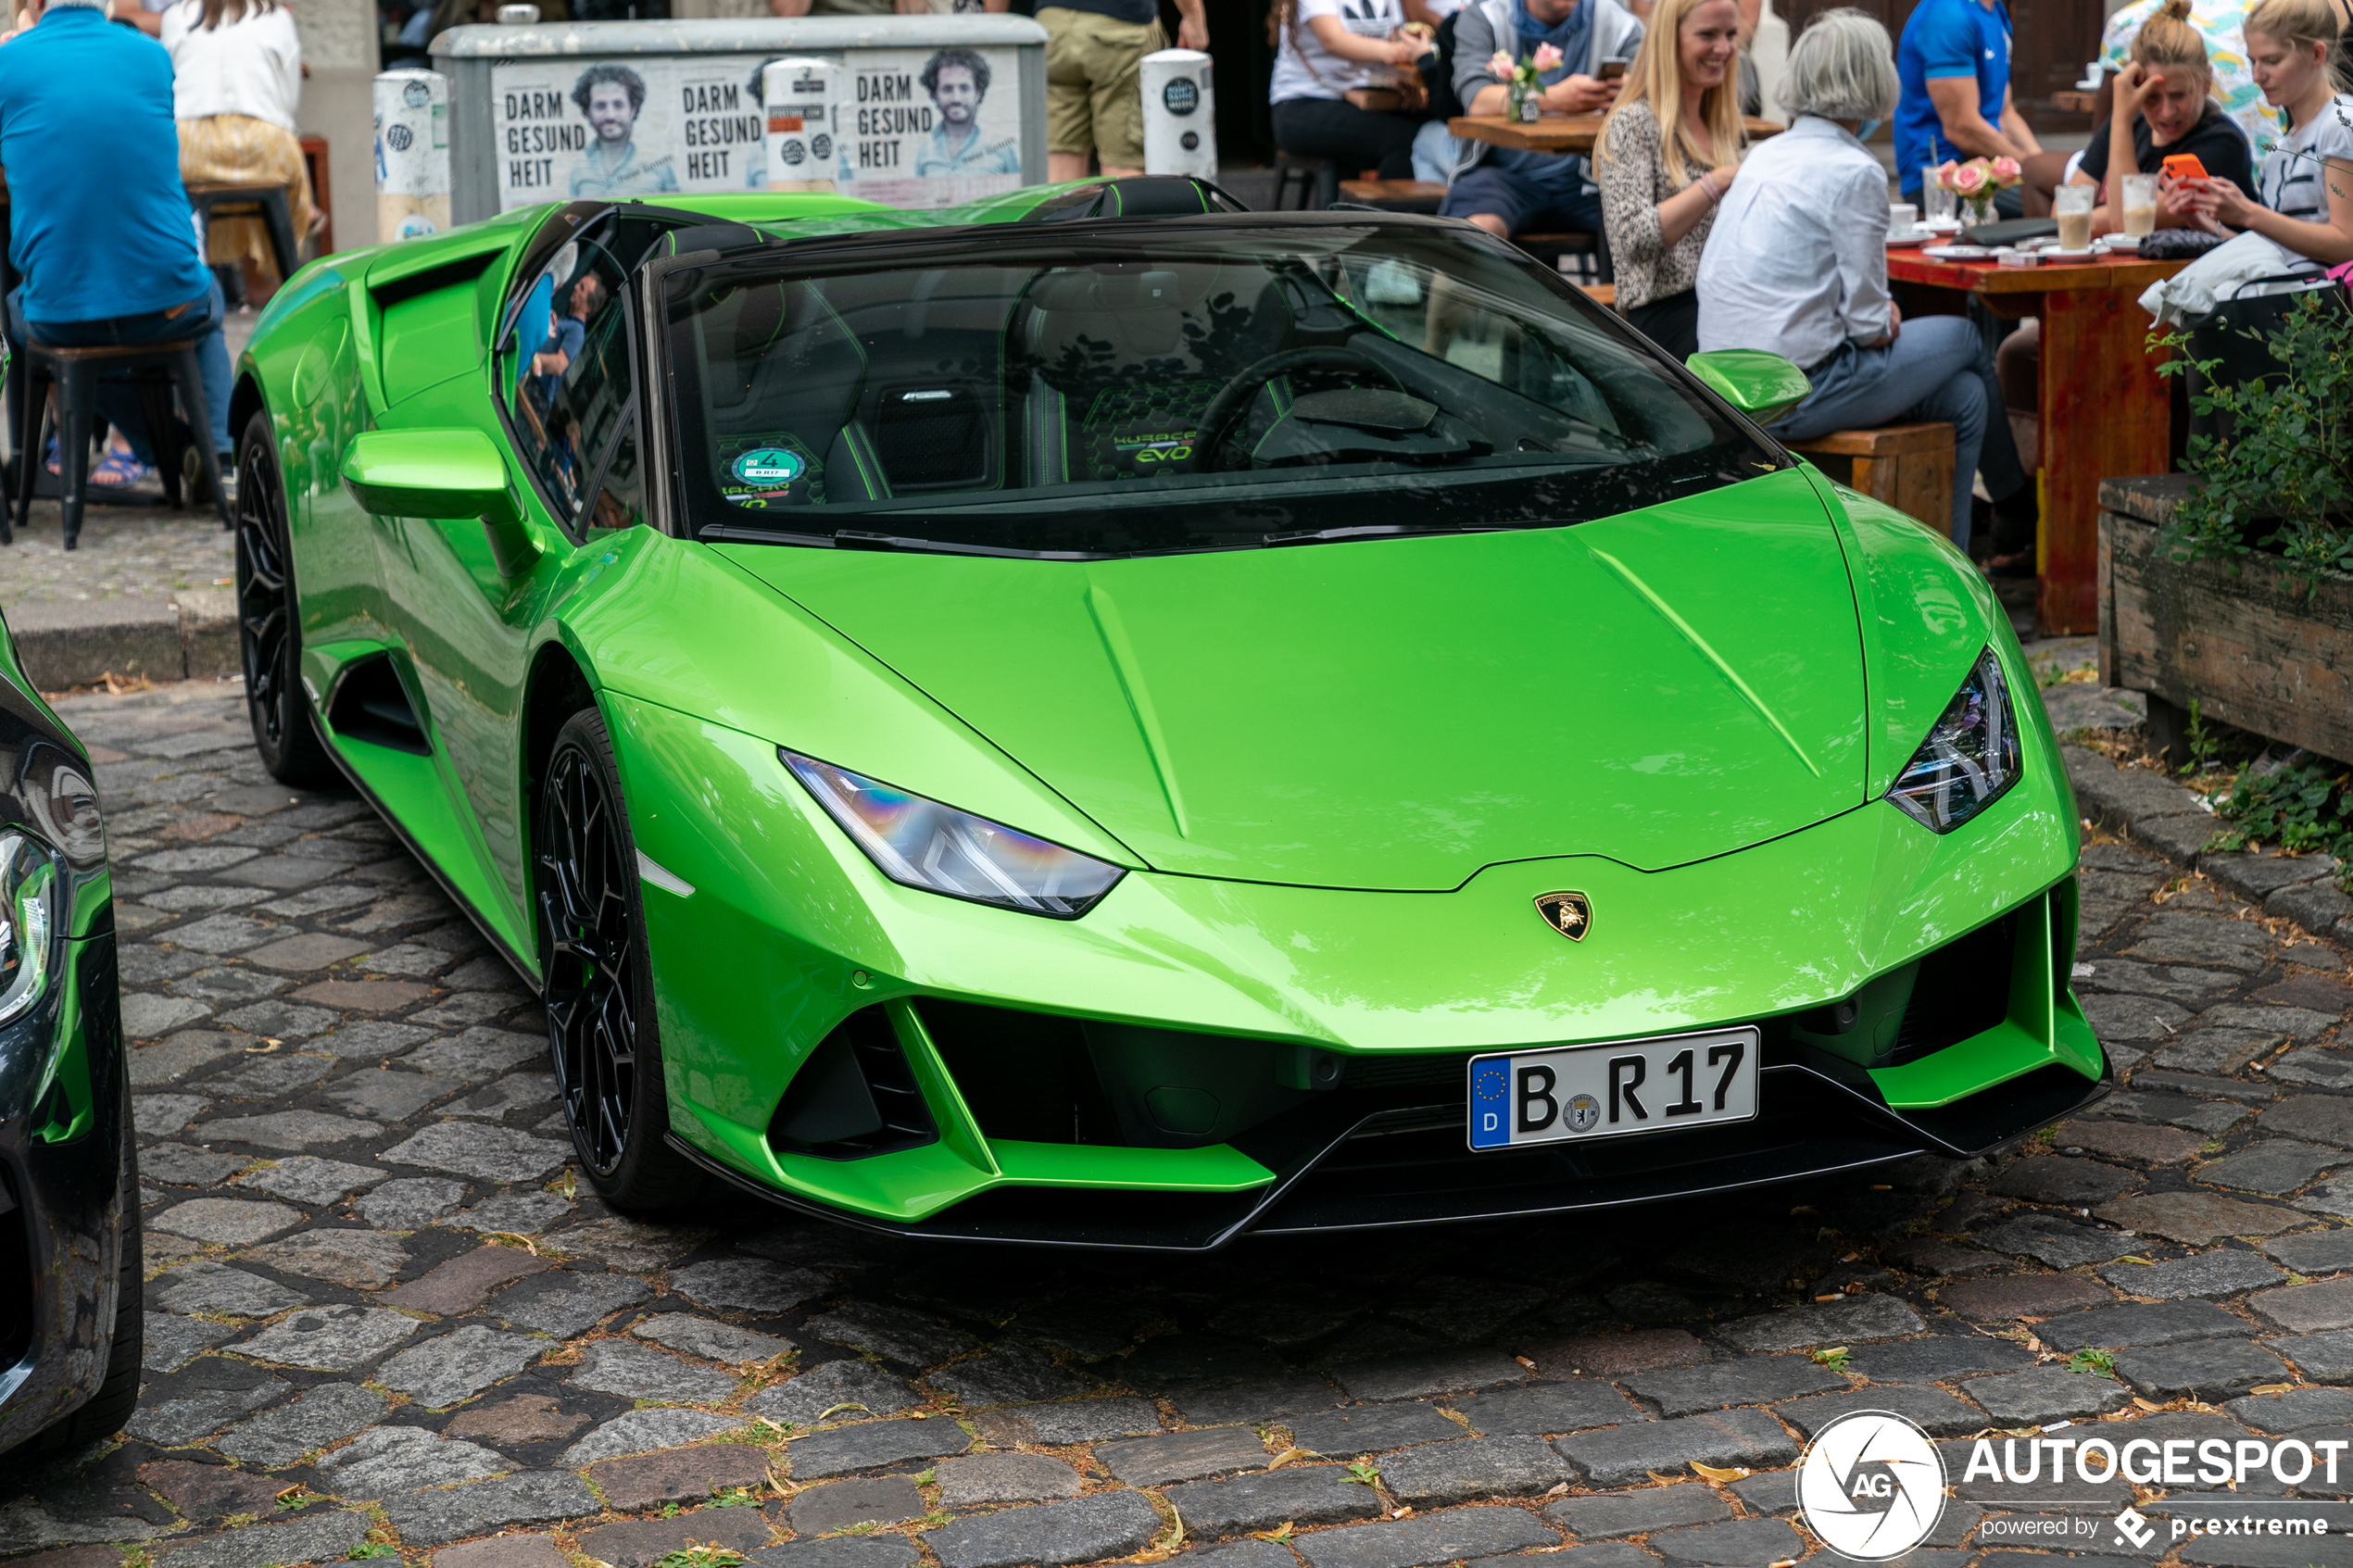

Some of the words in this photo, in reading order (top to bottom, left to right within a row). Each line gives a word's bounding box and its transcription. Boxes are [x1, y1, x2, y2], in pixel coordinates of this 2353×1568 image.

[683, 83, 739, 113] DARM
[857, 75, 912, 103] DARM
[505, 92, 564, 121] DARM
[686, 116, 761, 147] GESUND
[858, 107, 934, 136] GESUND
[508, 124, 586, 154] GESUND
[687, 151, 730, 181] HEIT
[860, 141, 901, 169] HEIT
[510, 159, 553, 188] HEIT
[761, 452, 778, 468] 4
[1135, 445, 1192, 463] EVO
[1539, 895, 1584, 907] LAMBORGHINI
[1517, 1063, 1559, 1134] B
[1483, 1112, 1498, 1132] D
